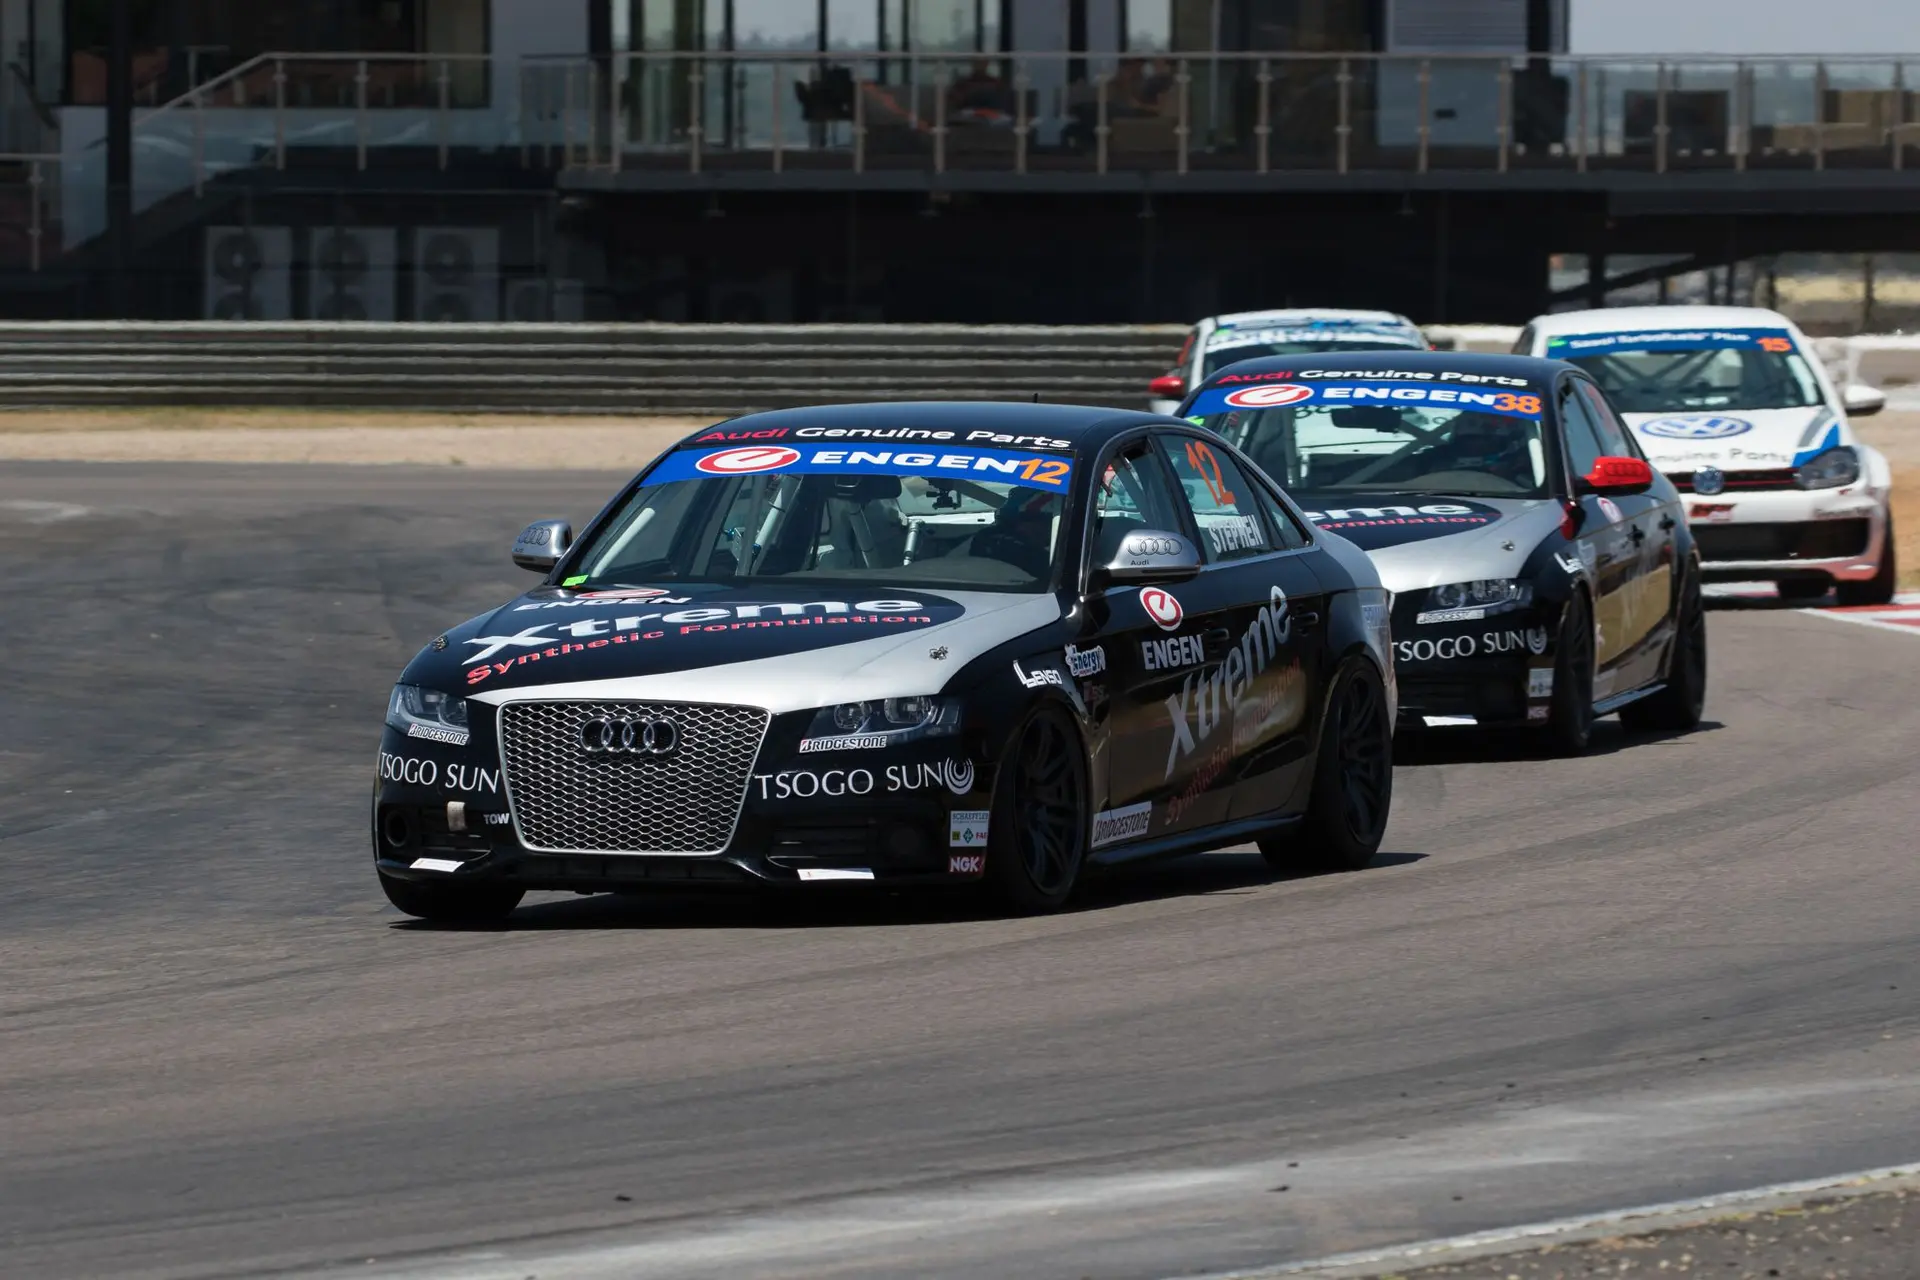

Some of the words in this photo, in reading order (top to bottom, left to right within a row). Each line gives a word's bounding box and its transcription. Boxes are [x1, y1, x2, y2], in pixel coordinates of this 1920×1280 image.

[1756, 337, 1792, 352] 15
[1215, 371, 1293, 385] Audi
[1299, 369, 1435, 381] Genuine
[1440, 371, 1529, 388] Parts
[1322, 388, 1498, 406] ENGEN
[1493, 393, 1542, 415] 38
[696, 427, 788, 442] Audi
[795, 427, 956, 441] Genuine
[966, 430, 1072, 449] Parts
[811, 450, 1022, 474] ENGEN
[1018, 458, 1071, 486] 12
[1185, 441, 1236, 508] 12
[1208, 514, 1264, 553] STEPHEN
[1316, 515, 1488, 530] ormulation
[462, 599, 923, 666] Xtreme
[1483, 629, 1525, 654] SUN
[467, 631, 664, 684] Synthetic
[680, 612, 931, 636] Formulation
[1141, 634, 1205, 670] ENGEN
[1164, 585, 1292, 781] Xtreme
[408, 724, 470, 745] BRIDGESTONE
[799, 735, 887, 753] BRIDGESTONE
[379, 752, 437, 786] TSOGO
[445, 763, 499, 794] SUN
[755, 769, 874, 799] TSOGO
[886, 761, 943, 791] SUN
[484, 812, 510, 825] TOW
[1093, 810, 1151, 843] BRIDGESTONE
[950, 856, 980, 873] NGK
